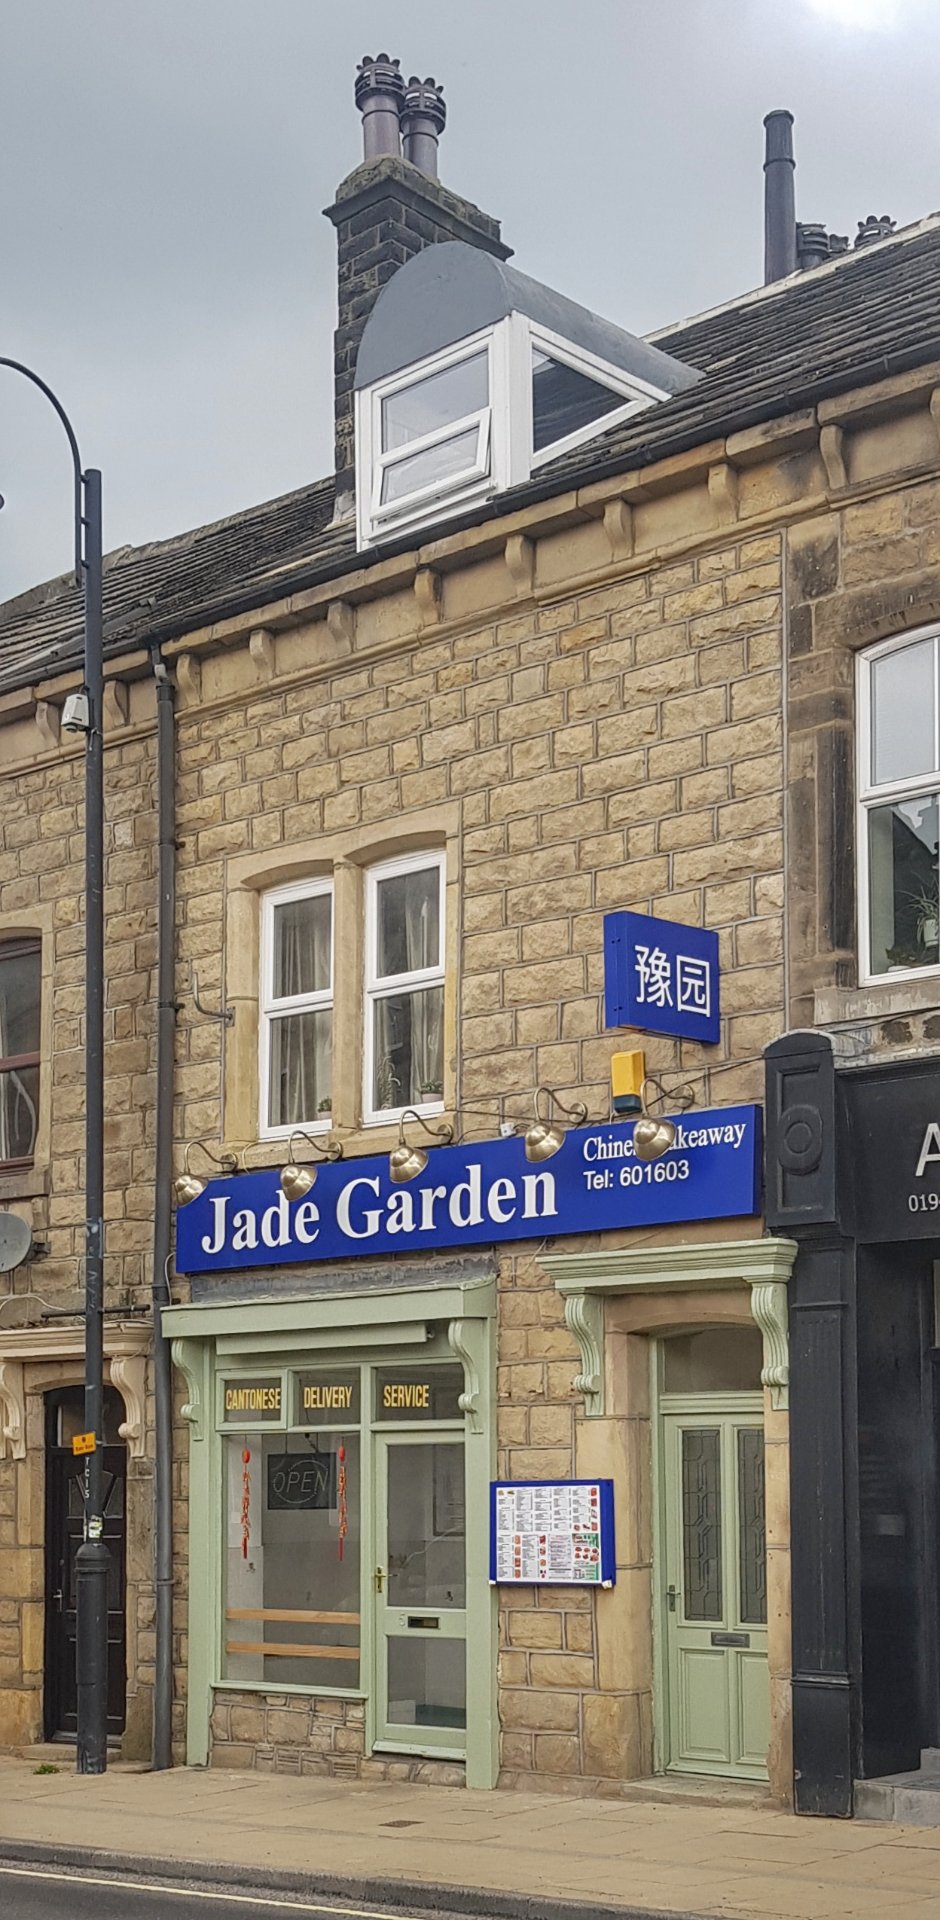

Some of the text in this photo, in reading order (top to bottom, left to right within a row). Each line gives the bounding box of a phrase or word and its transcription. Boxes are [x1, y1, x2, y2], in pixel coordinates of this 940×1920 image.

[634, 944, 711, 1018] 豫园
[583, 1135, 636, 1162] Chine
[583, 1160, 689, 1190] Tel: 601603
[201, 1163, 559, 1254] Jade Garden
[908, 1193, 940, 1212] 019
[225, 1387, 281, 1410] CANTONESE
[303, 1386, 353, 1409] DELIVERY
[383, 1384, 430, 1408] SERVICE
[273, 1470, 329, 1493] OPEN
